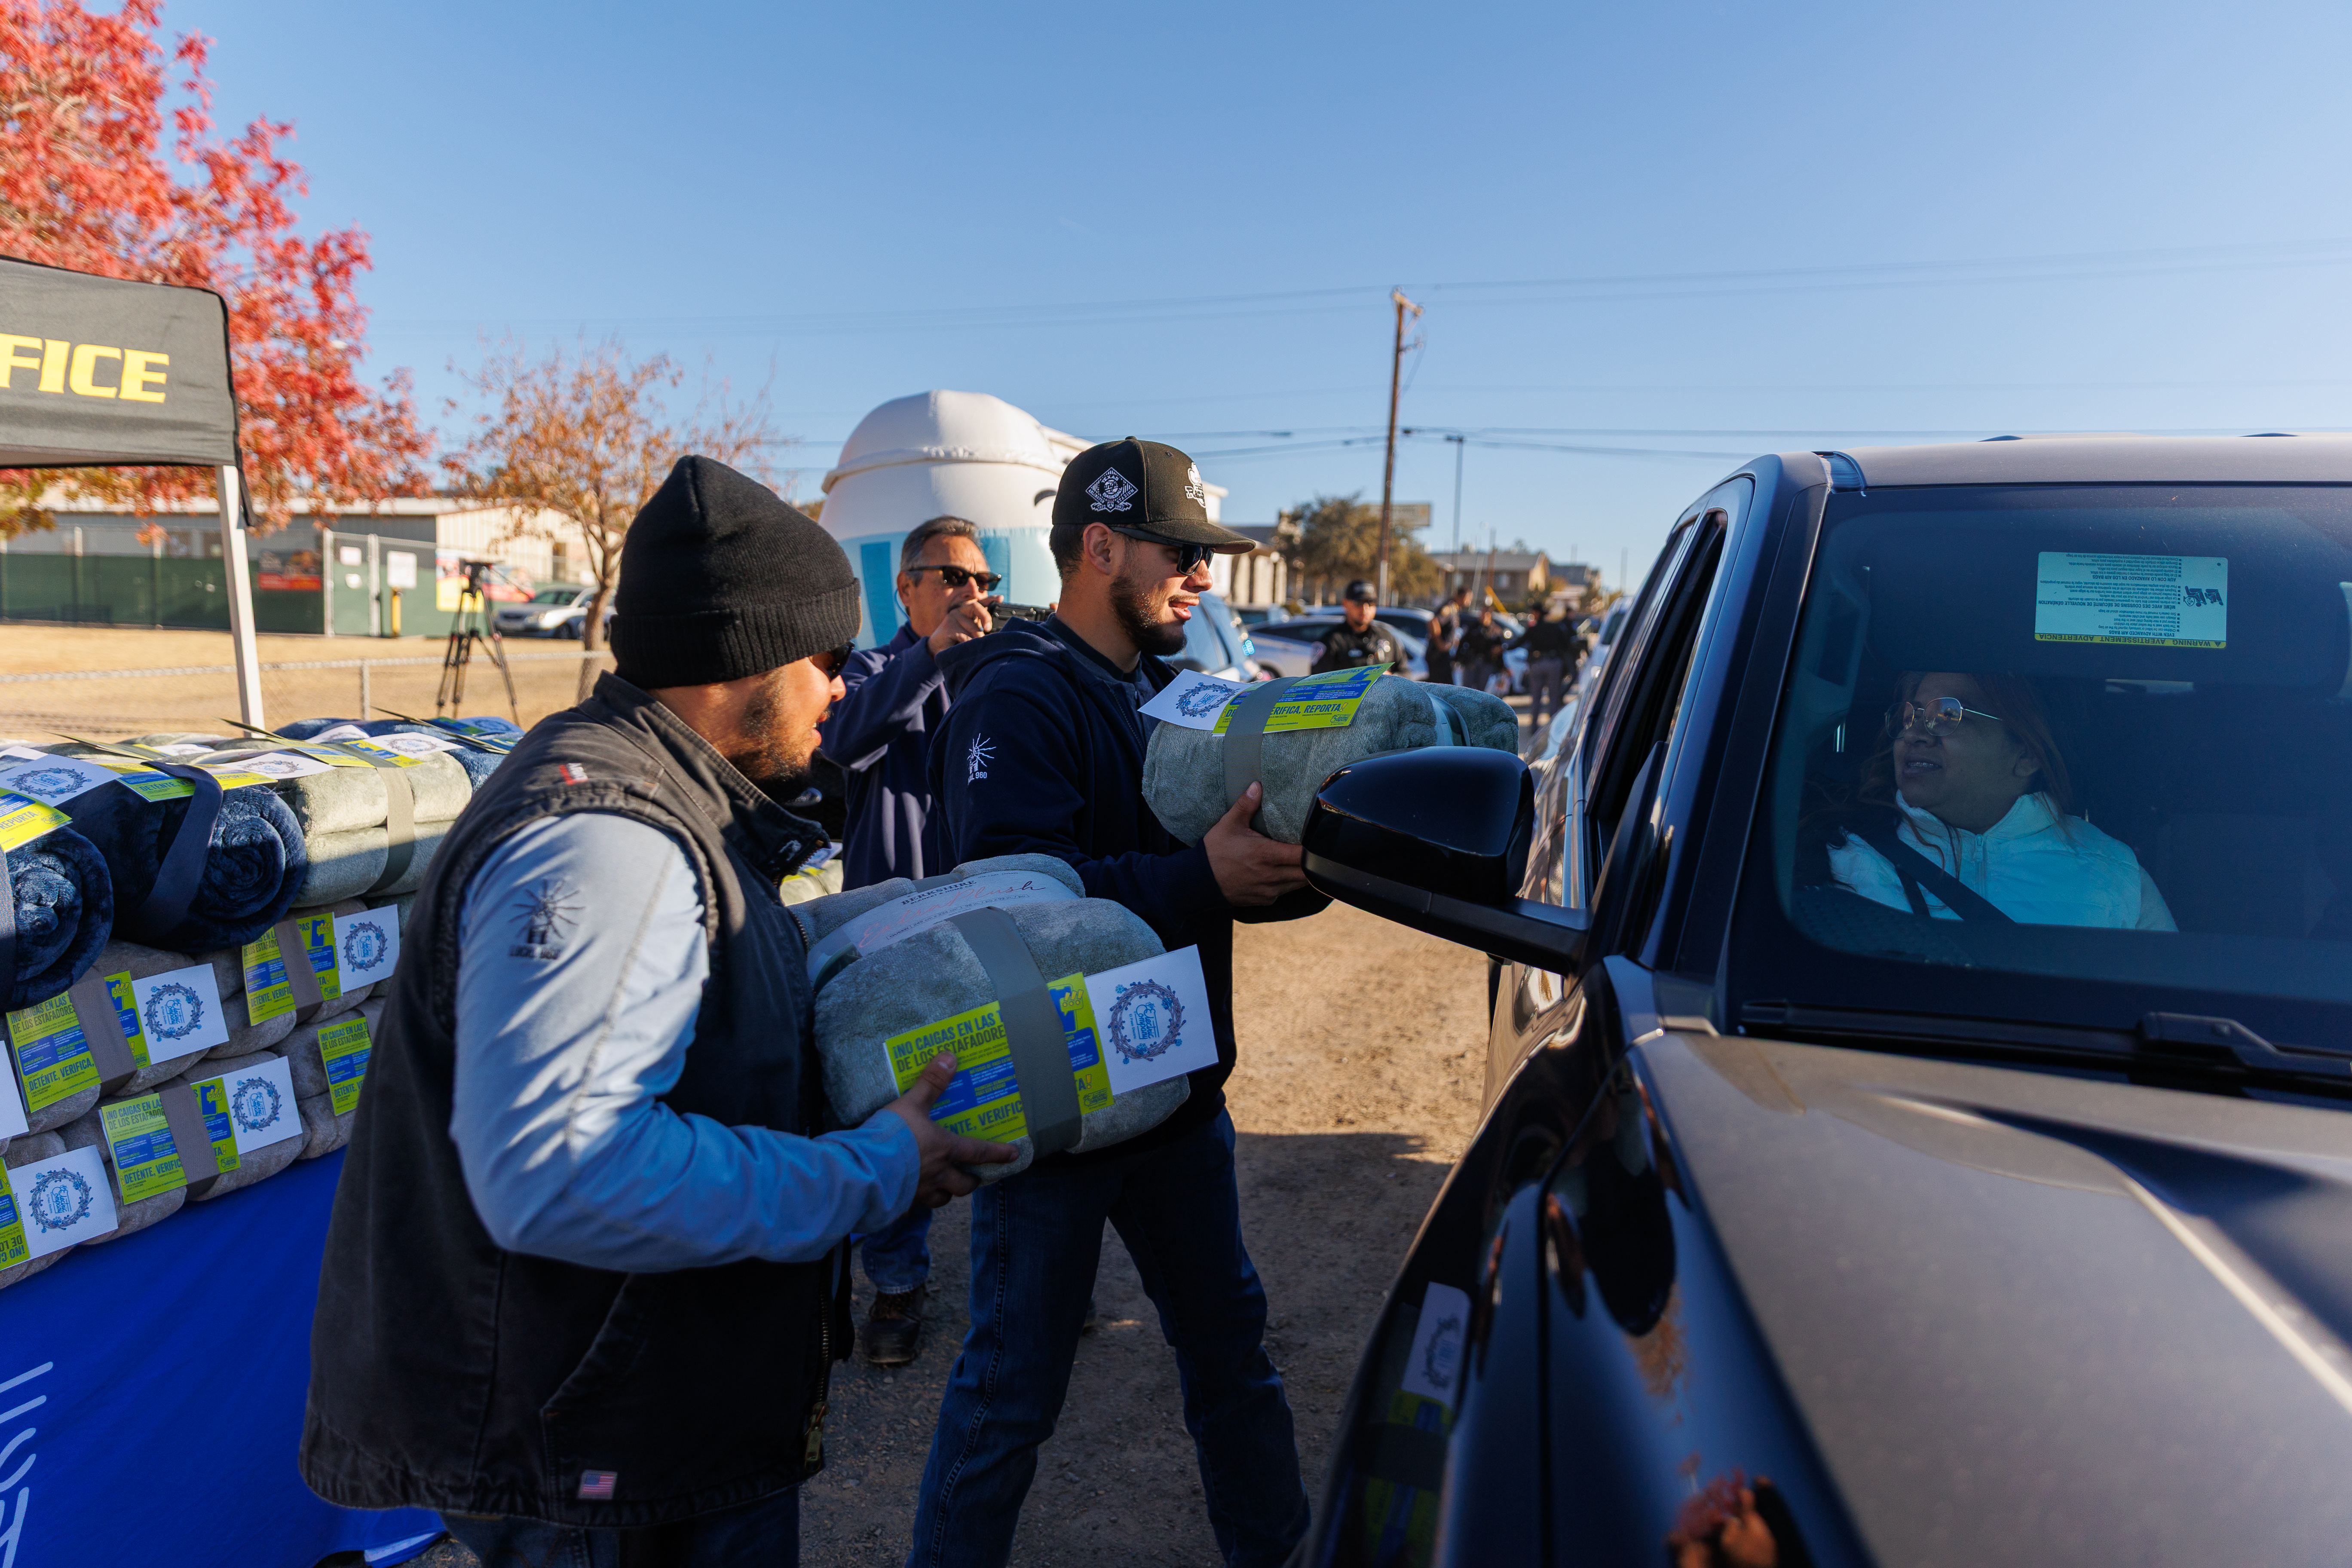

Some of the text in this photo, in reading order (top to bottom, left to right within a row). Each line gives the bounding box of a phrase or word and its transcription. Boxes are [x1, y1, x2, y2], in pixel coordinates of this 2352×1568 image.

[1088, 488, 1134, 504] ARLINGTON STADIUM
[1102, 487, 1122, 499] BASEBALL
[1270, 702, 1348, 715] ERIFICA, REPORTA!
[901, 880, 977, 906] BERKSHIRE
[911, 894, 937, 904] BLANKET
[889, 927, 909, 937] QUEEN
[256, 938, 279, 953] ESTAFADO
[272, 986, 292, 999] VERIFI
[44, 1000, 54, 1011] EN
[54, 995, 67, 1007] LAS
[12, 1023, 21, 1034] DE
[21, 1018, 34, 1030] LOS
[346, 1026, 353, 1035] EN
[354, 1023, 363, 1032] LAS
[1136, 1004, 1148, 1039] Company
[1144, 1008, 1156, 1038] Electric
[892, 1012, 996, 1059] ¡NO CAIGAS EN LAS
[322, 1042, 328, 1050] DE
[329, 1039, 337, 1049] LOS
[896, 1056, 912, 1073] DE
[913, 1047, 936, 1067] LOS
[937, 1023, 1006, 1059] ESTAFADORE
[59, 1056, 95, 1079] VERIFICA,
[105, 1109, 117, 1120] ¡NO
[117, 1103, 141, 1117] CAIGAS
[141, 1101, 151, 1111] EN
[108, 1120, 118, 1130] DE
[117, 1116, 130, 1127] LOS
[130, 1107, 165, 1124] ESTAFADOR
[977, 1099, 1023, 1126] VERIFIC
[155, 1158, 182, 1175] VERIFIC
[10, 1234, 23, 1247] DE
